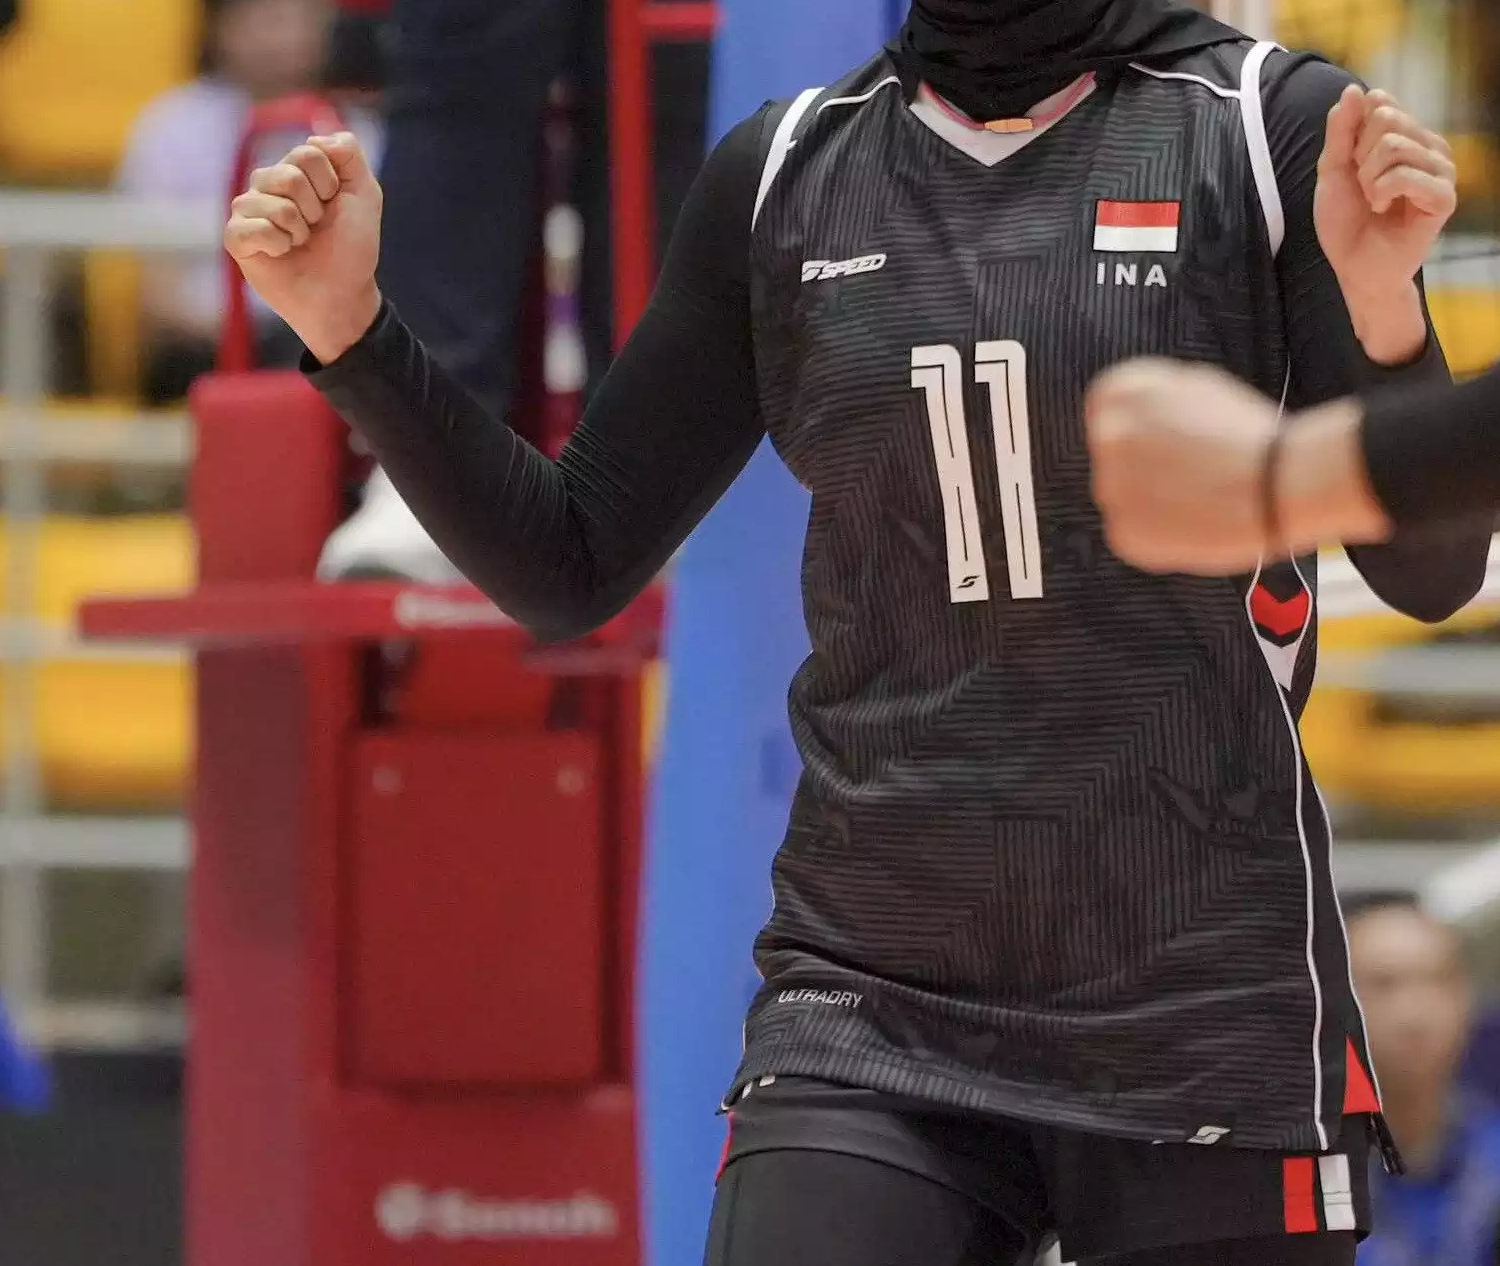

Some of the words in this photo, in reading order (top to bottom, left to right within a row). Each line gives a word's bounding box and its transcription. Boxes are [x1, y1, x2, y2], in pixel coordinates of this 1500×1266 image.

[1096, 262, 1168, 288] INA
[910, 339, 1043, 603] 11
[778, 988, 863, 1008] ULTRADRY
